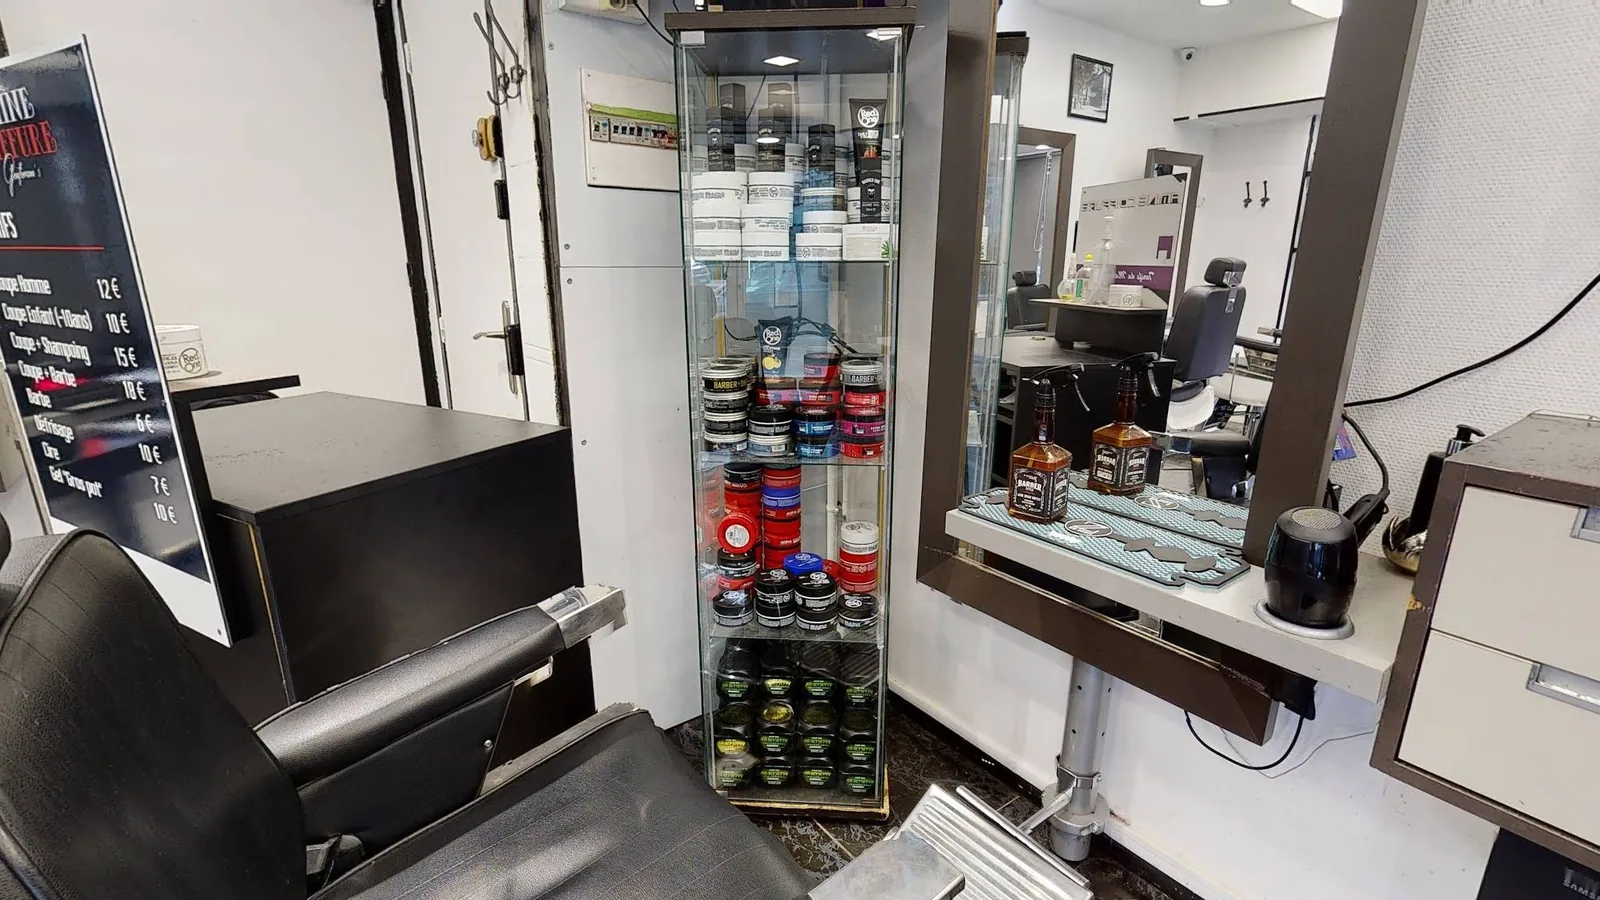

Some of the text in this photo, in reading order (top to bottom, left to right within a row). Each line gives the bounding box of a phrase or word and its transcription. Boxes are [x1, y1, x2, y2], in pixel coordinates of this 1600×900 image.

[17, 274, 52, 295] Homme
[1, 302, 28, 327] Coupe
[25, 305, 56, 326] Enfant
[9, 332, 36, 356] Coupe
[40, 337, 92, 367] Shampoing
[18, 360, 44, 383] Coupe
[48, 366, 77, 388] Barbe
[713, 381, 738, 389] BARBER
[26, 387, 52, 408] Barbe
[48, 465, 65, 484] Gel
[1017, 479, 1043, 491] BARBER
